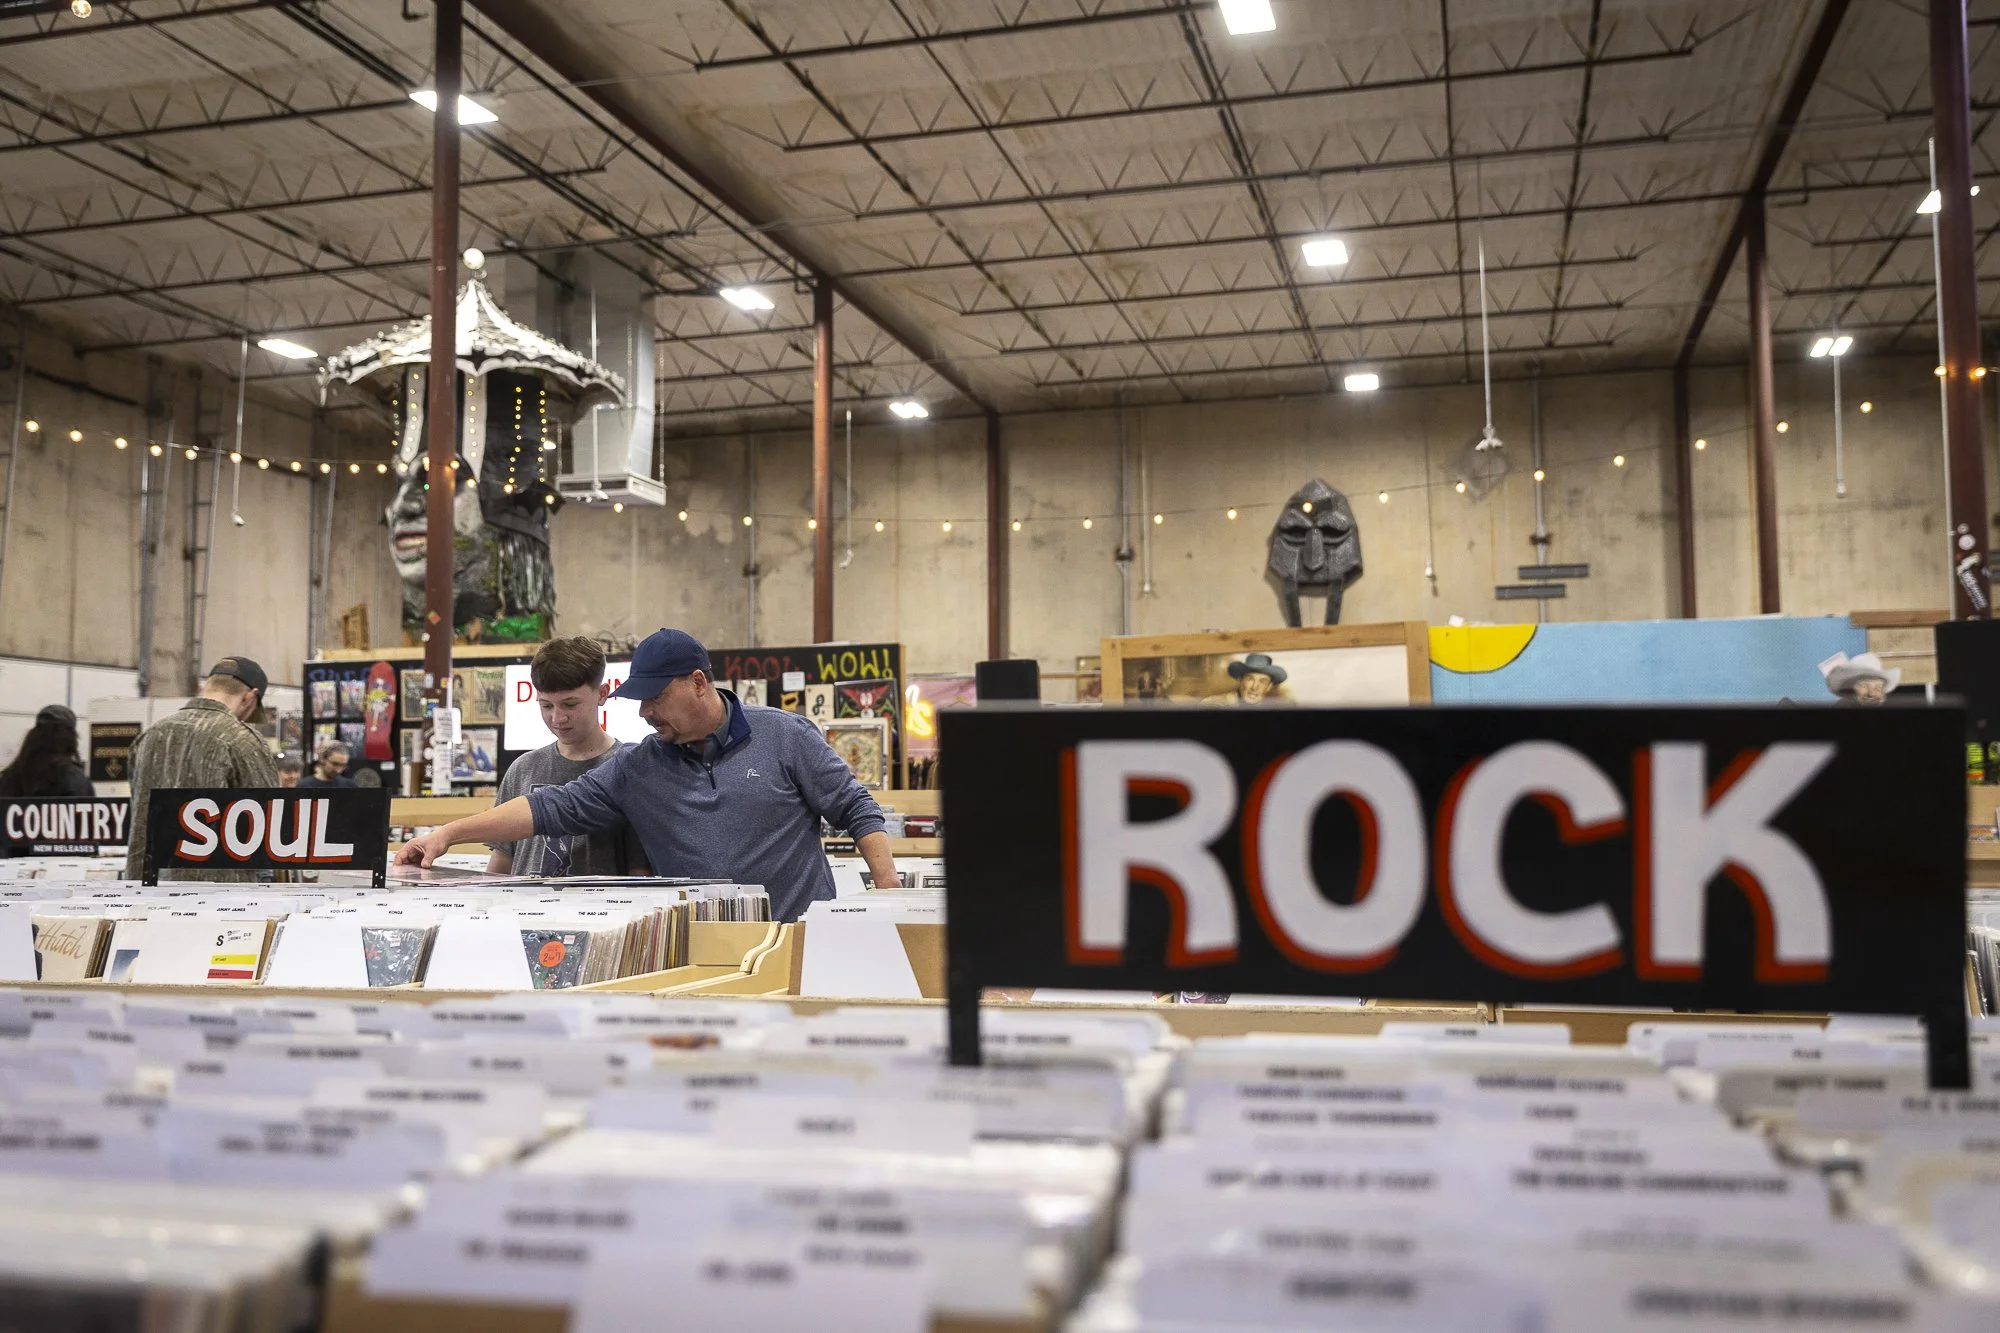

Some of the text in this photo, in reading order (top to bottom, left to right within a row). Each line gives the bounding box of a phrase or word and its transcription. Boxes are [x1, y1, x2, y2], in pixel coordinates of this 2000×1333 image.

[817, 648, 893, 681] WOW!
[6, 803, 128, 840] COUNTRY
[176, 798, 354, 861] SOUL
[1062, 739, 1837, 980] ROCK
[36, 921, 87, 959] Hutch
[543, 953, 549, 962] 2
